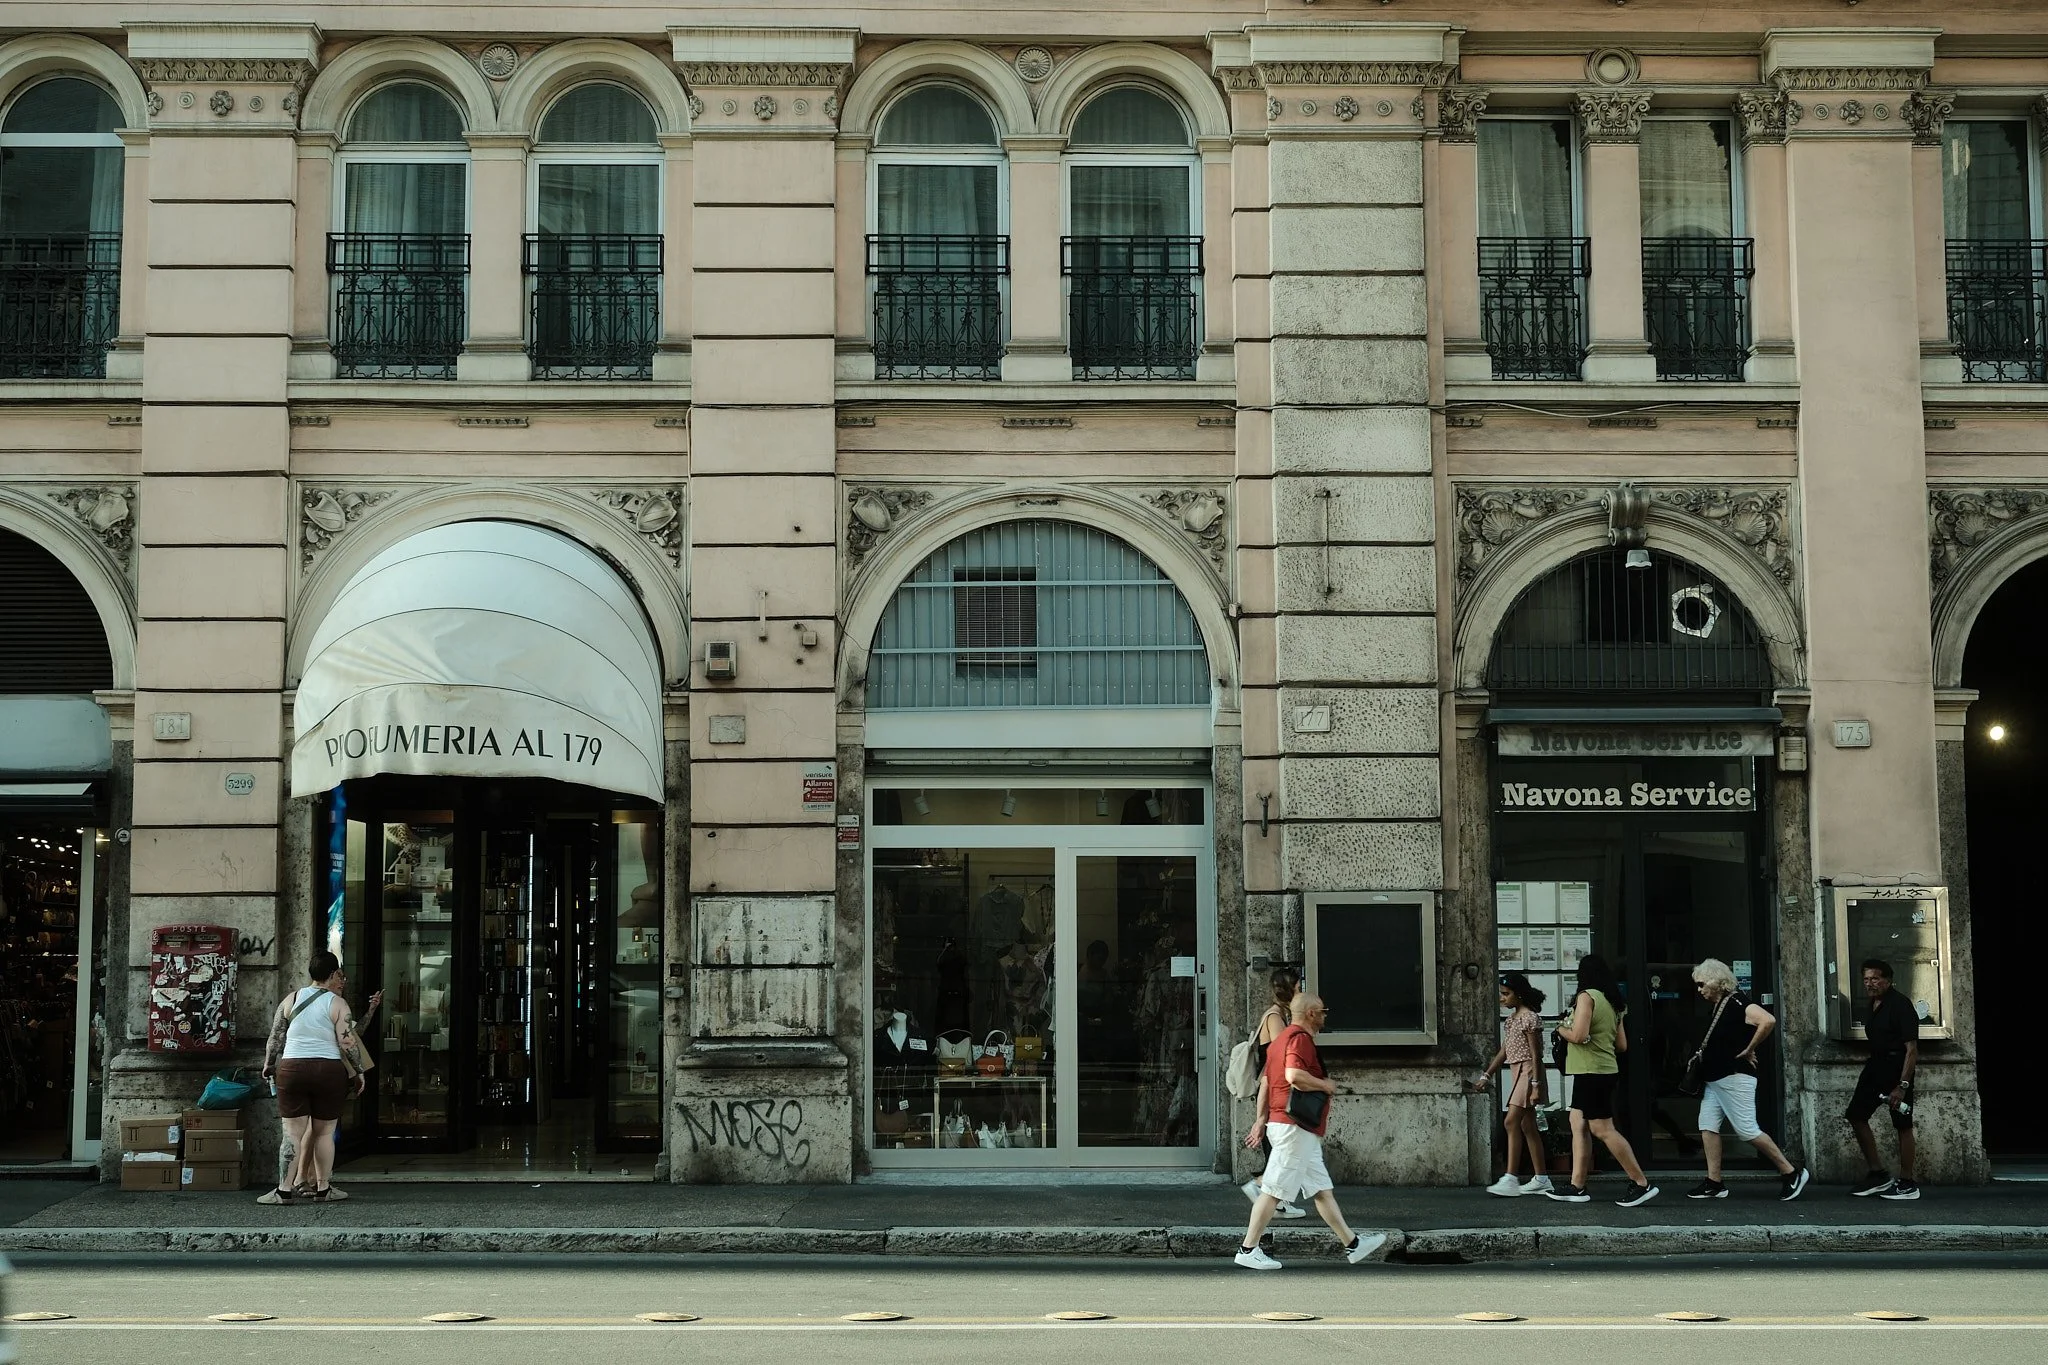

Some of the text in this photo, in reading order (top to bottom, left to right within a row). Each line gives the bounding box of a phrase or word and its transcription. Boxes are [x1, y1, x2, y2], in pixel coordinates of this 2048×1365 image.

[161, 718, 184, 734] 181
[1300, 711, 1324, 726] 177
[1530, 726, 1743, 752] Navona Service
[1840, 725, 1864, 742] 175
[511, 727, 554, 759] AL
[563, 732, 603, 766] 179
[227, 778, 254, 790] 3299
[1501, 781, 1751, 807] Navona Service
[172, 925, 206, 933] POSTE
